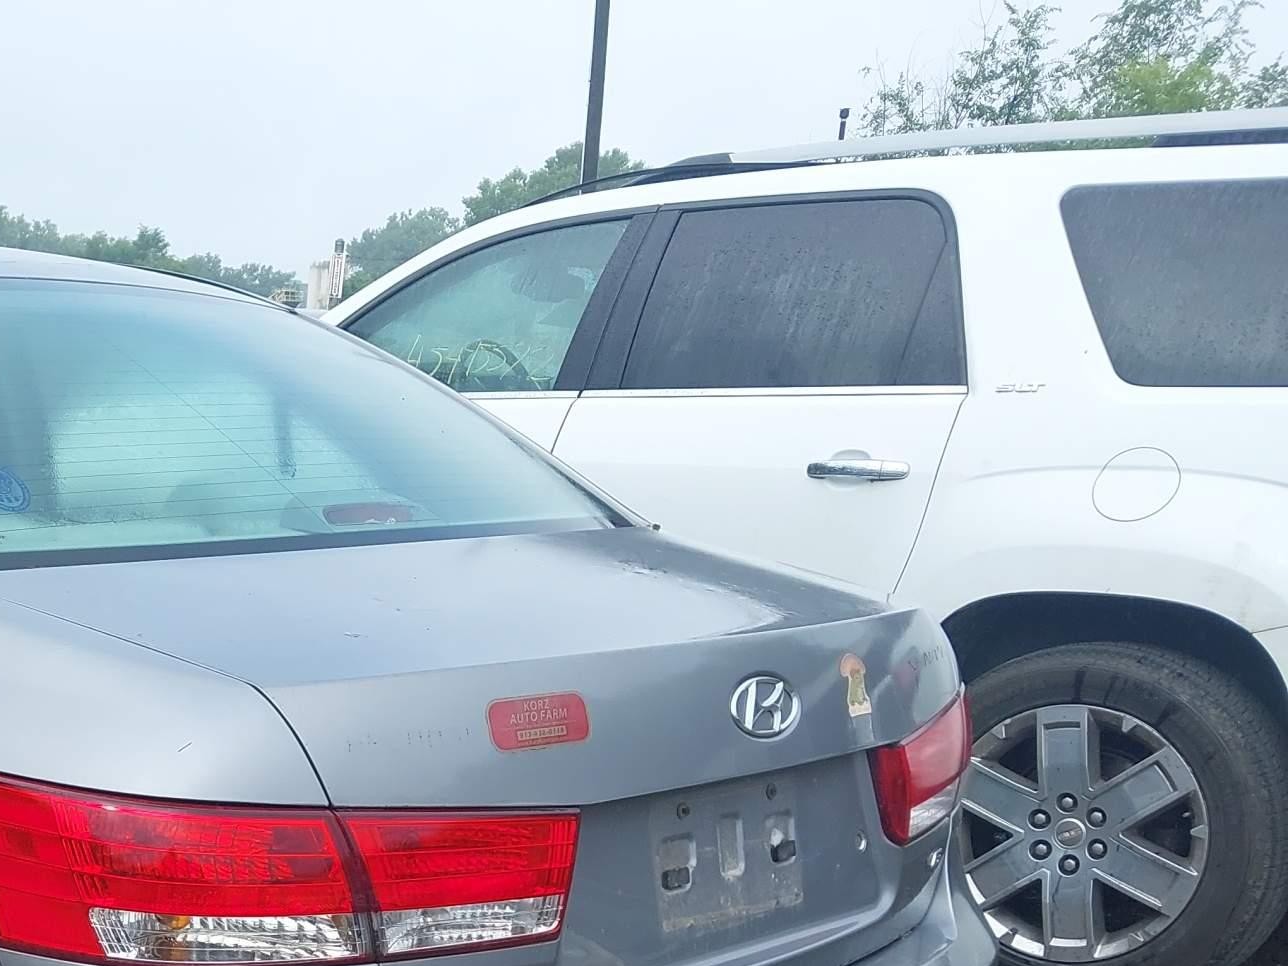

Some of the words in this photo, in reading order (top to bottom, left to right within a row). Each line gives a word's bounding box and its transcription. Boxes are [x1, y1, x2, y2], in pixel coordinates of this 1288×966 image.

[995, 384, 1046, 393] SLT
[523, 699, 550, 712] KORZ
[510, 711, 538, 725] AUTO
[540, 708, 568, 721] FARM
